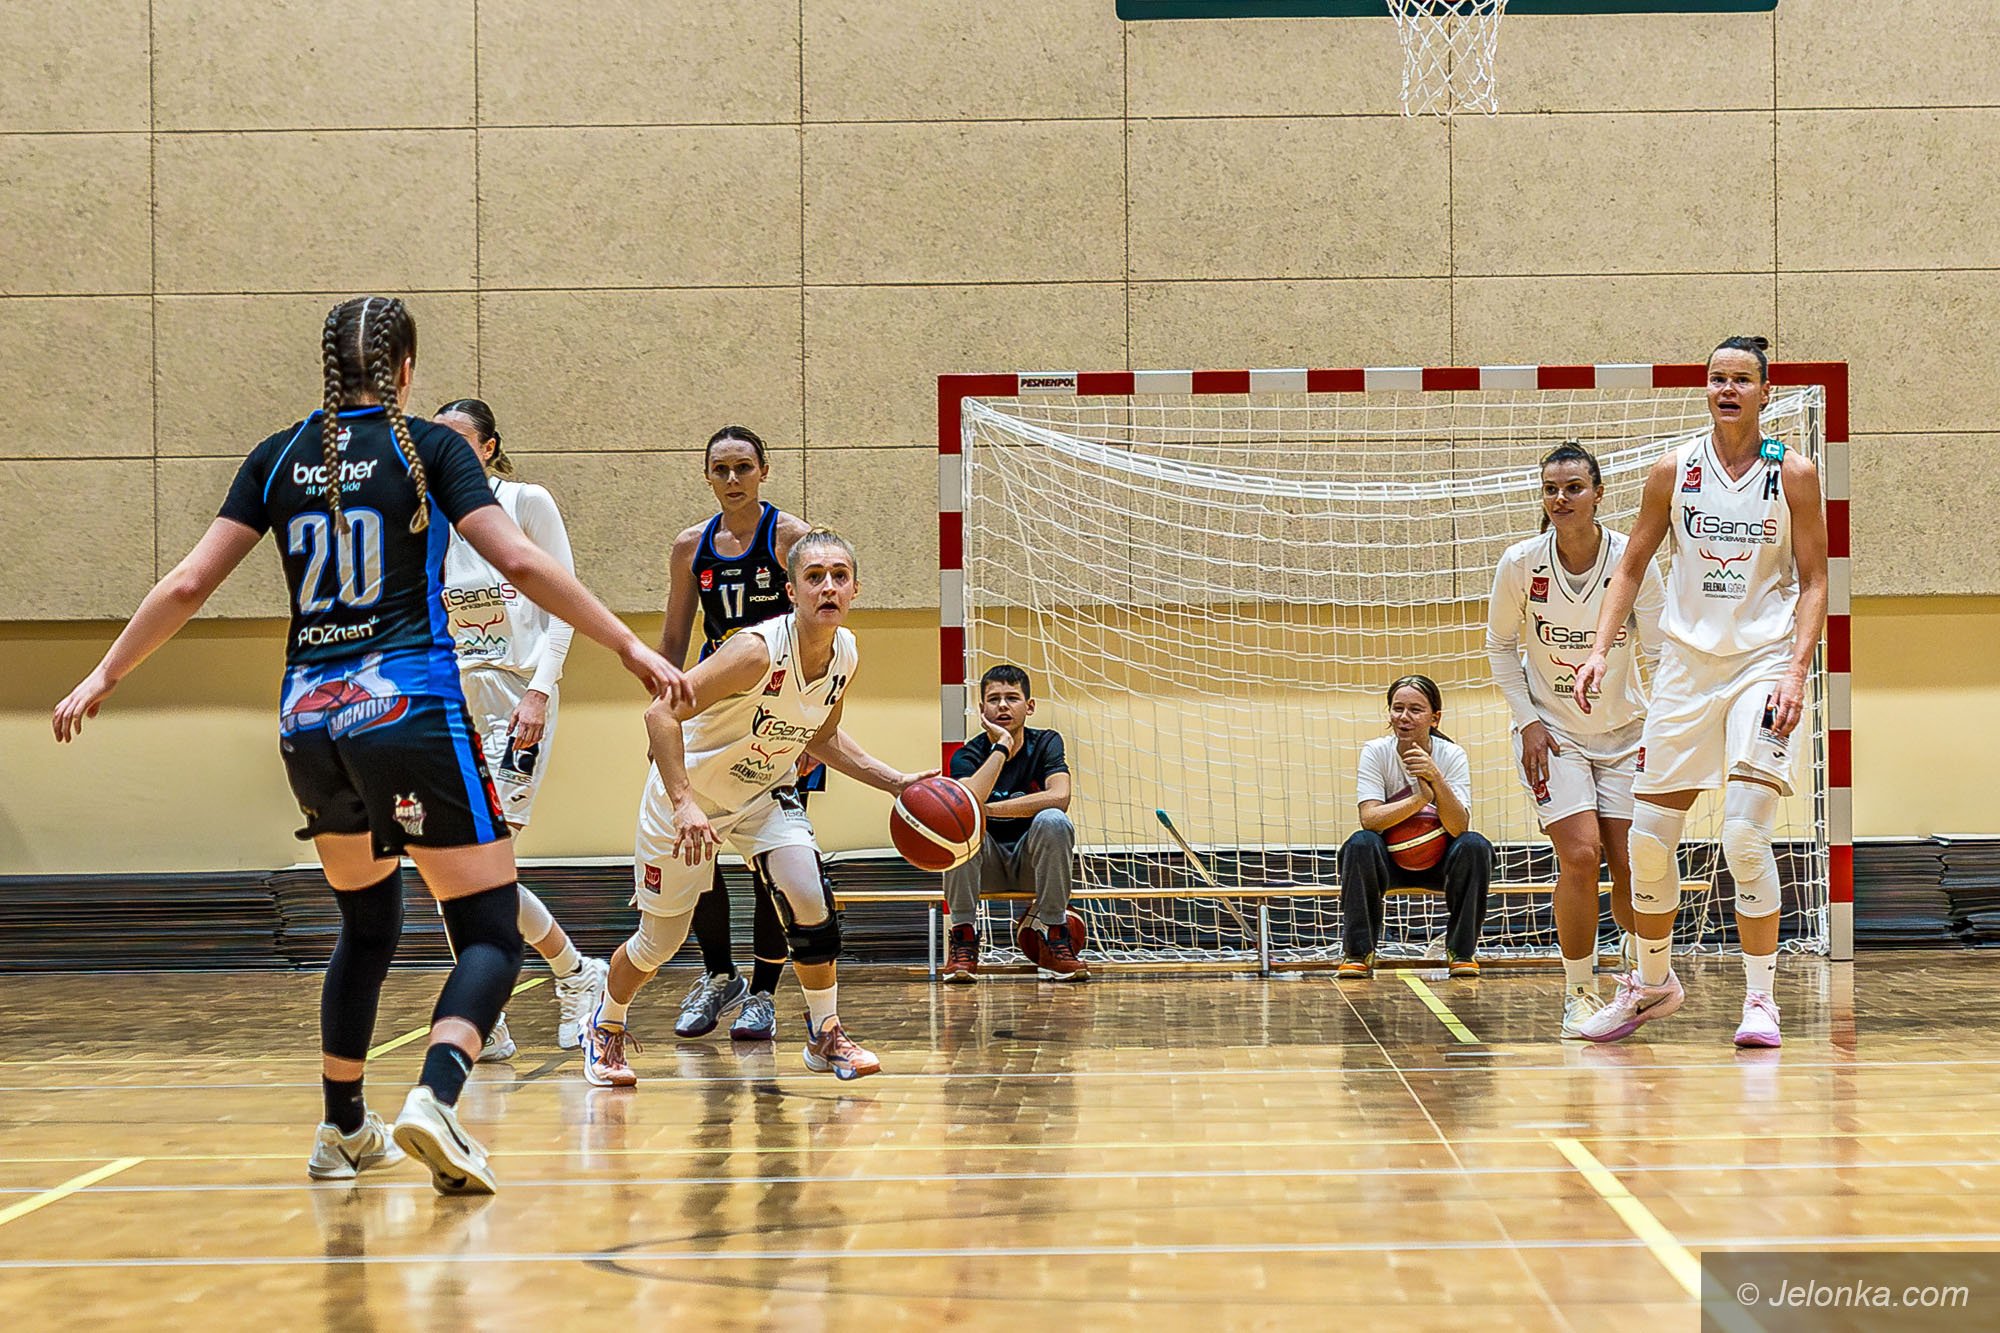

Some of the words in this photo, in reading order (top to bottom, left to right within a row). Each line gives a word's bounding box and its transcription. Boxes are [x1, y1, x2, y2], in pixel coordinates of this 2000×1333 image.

[293, 459, 378, 484] broher
[1763, 470, 1780, 501] 14
[1696, 516, 1778, 536] iSandS
[288, 506, 384, 615] 20
[444, 582, 517, 608] iSandS
[719, 583, 745, 619] 17
